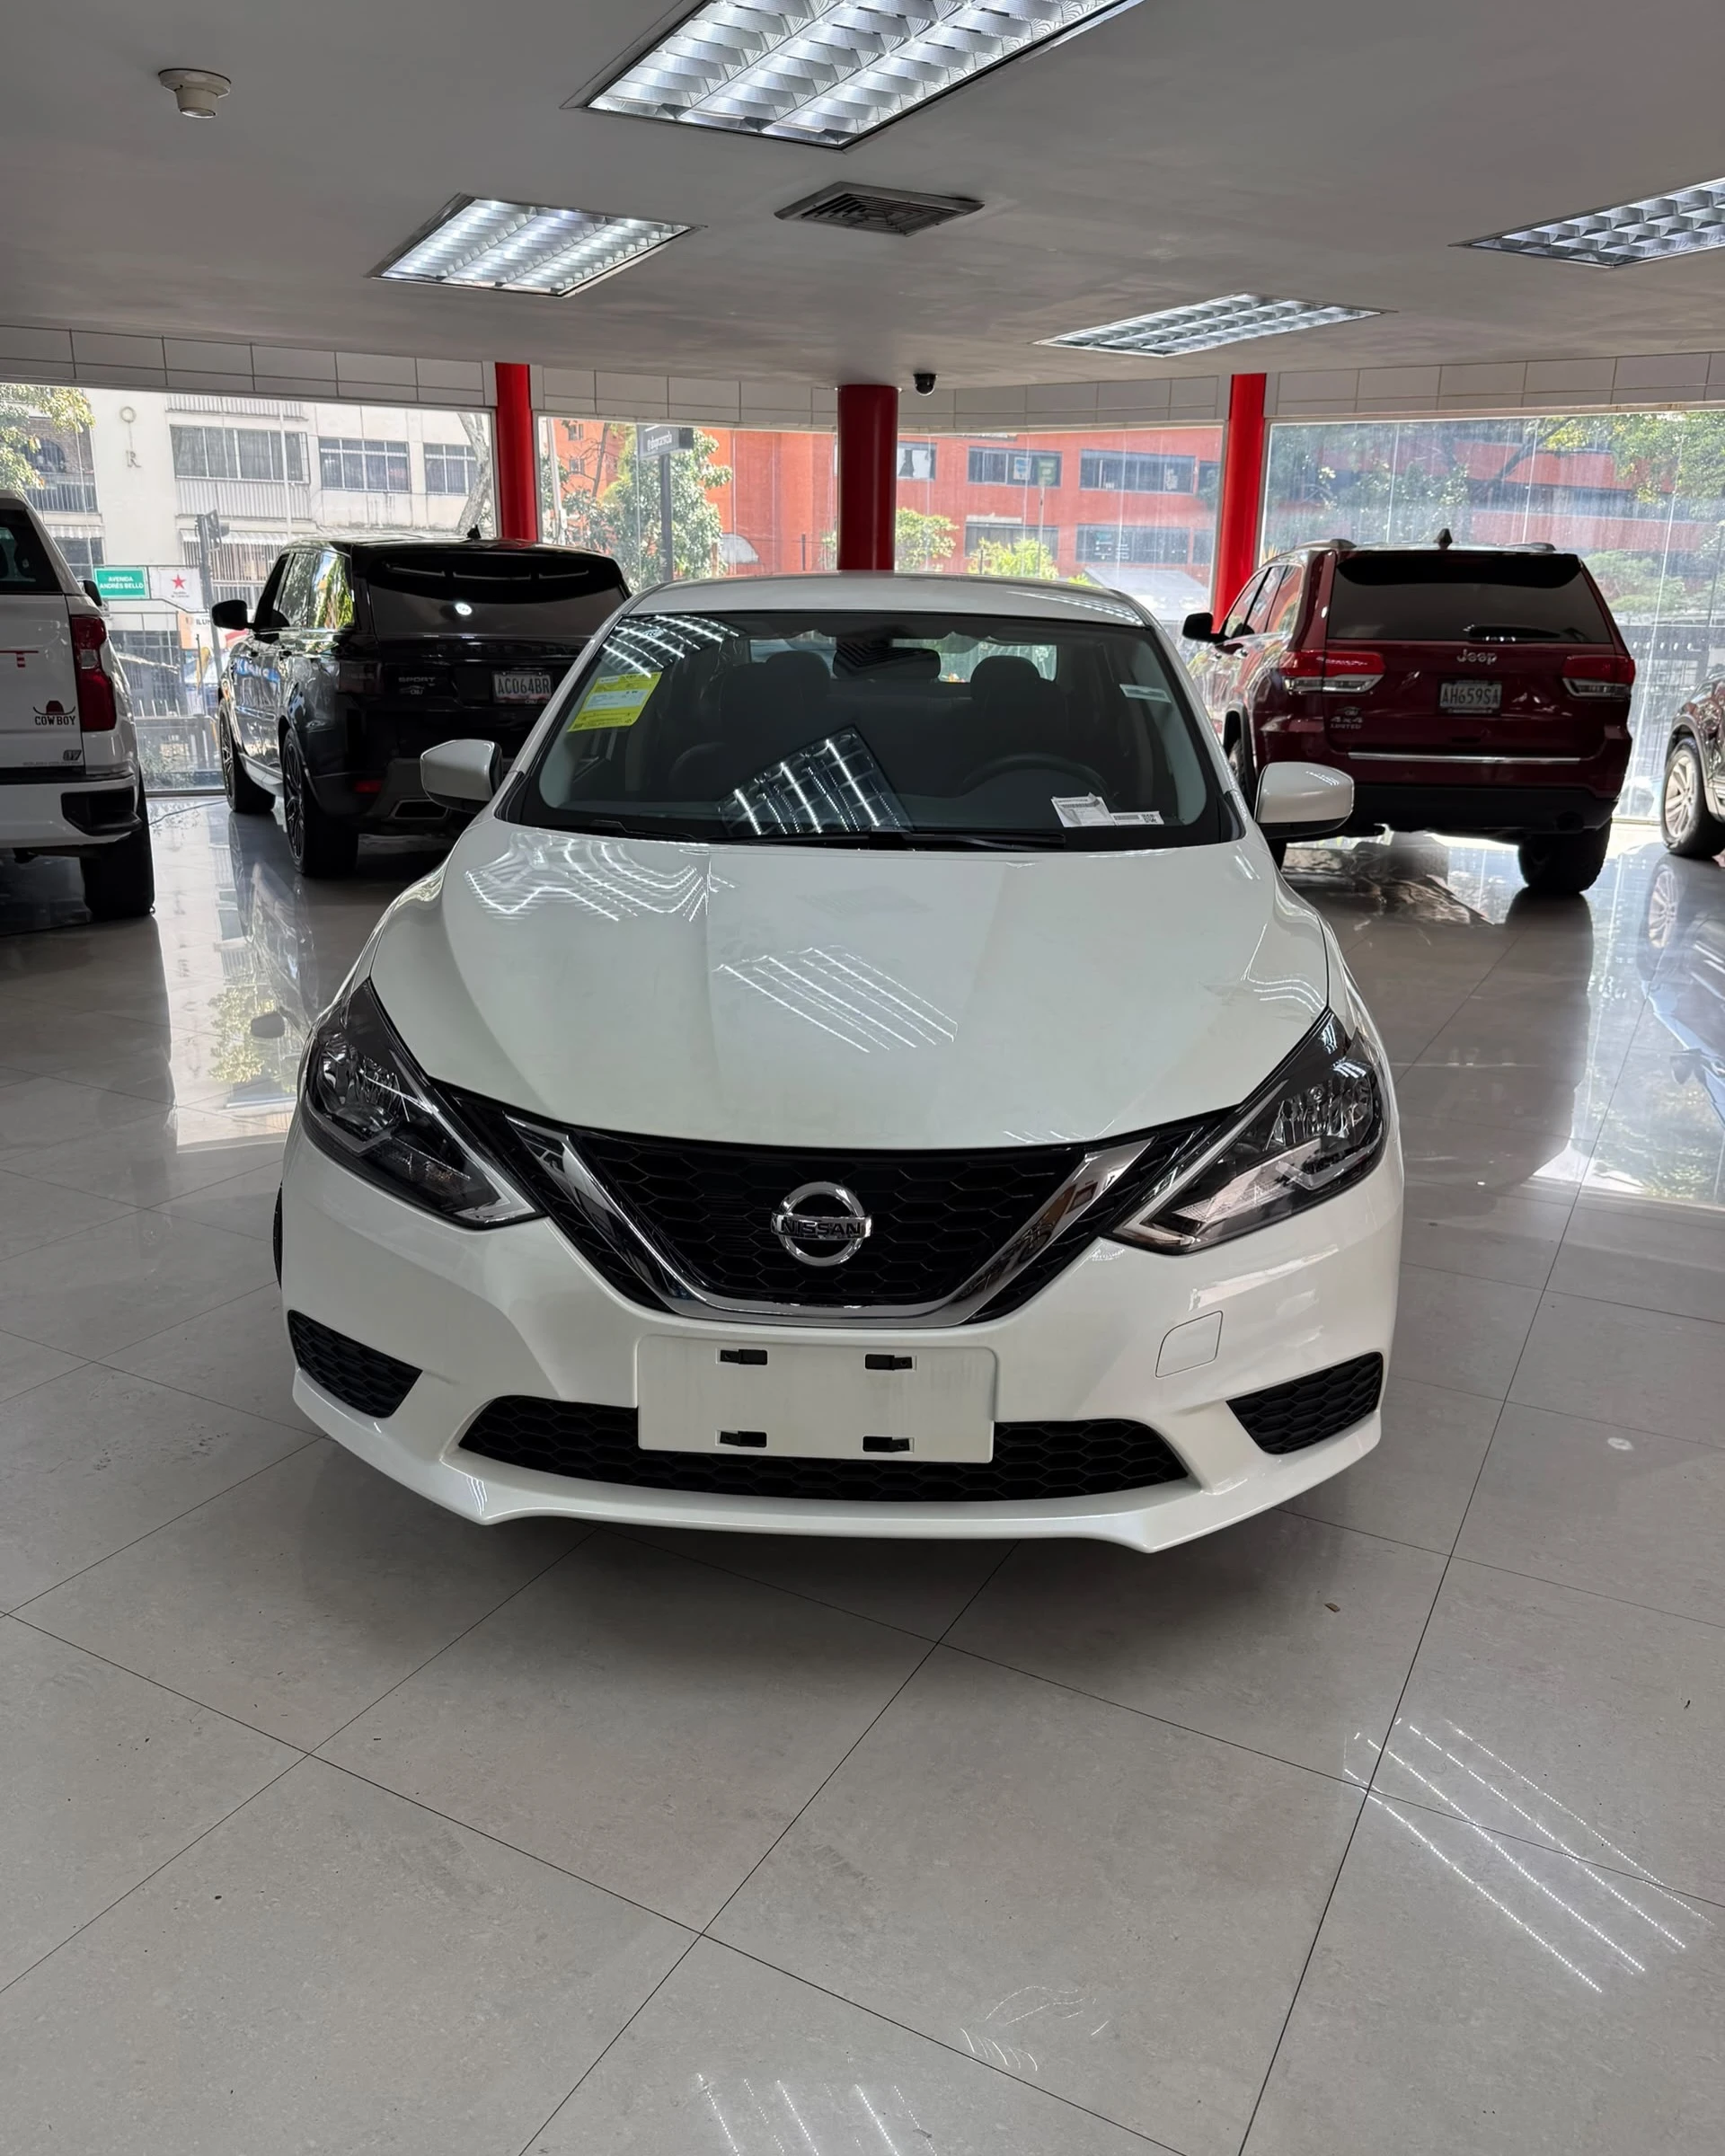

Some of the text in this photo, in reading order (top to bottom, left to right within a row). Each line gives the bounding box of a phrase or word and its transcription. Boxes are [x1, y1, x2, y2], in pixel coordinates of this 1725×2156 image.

[1456, 649, 1498, 665] Jeep
[497, 678, 551, 694] AC064BR
[1441, 688, 1499, 705] AH659SA
[34, 716, 76, 726] COWBOY
[780, 1218, 861, 1238] NISSAN
